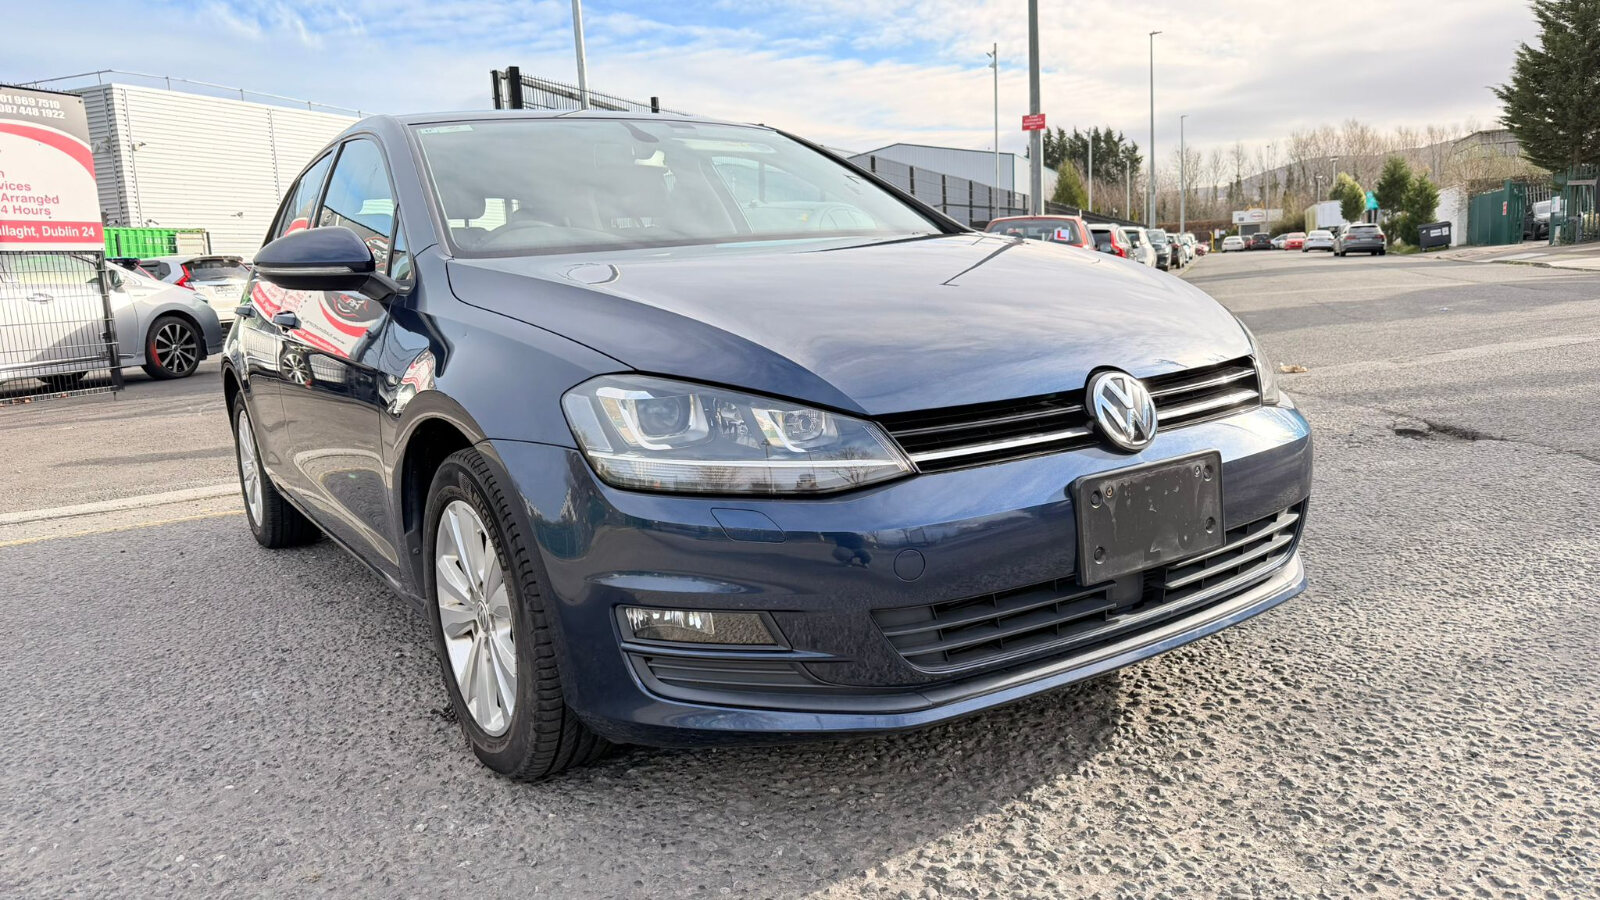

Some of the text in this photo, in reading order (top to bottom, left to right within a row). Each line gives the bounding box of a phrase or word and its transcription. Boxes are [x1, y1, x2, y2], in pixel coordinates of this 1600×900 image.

[13, 95, 36, 106] 969
[19, 105, 39, 117] 448
[40, 108, 65, 119] 1922
[1, 192, 60, 206] Arranged
[12, 204, 51, 216] Hours
[0, 225, 96, 239] llaght, Dublin 24
[1056, 230, 1067, 240] L
